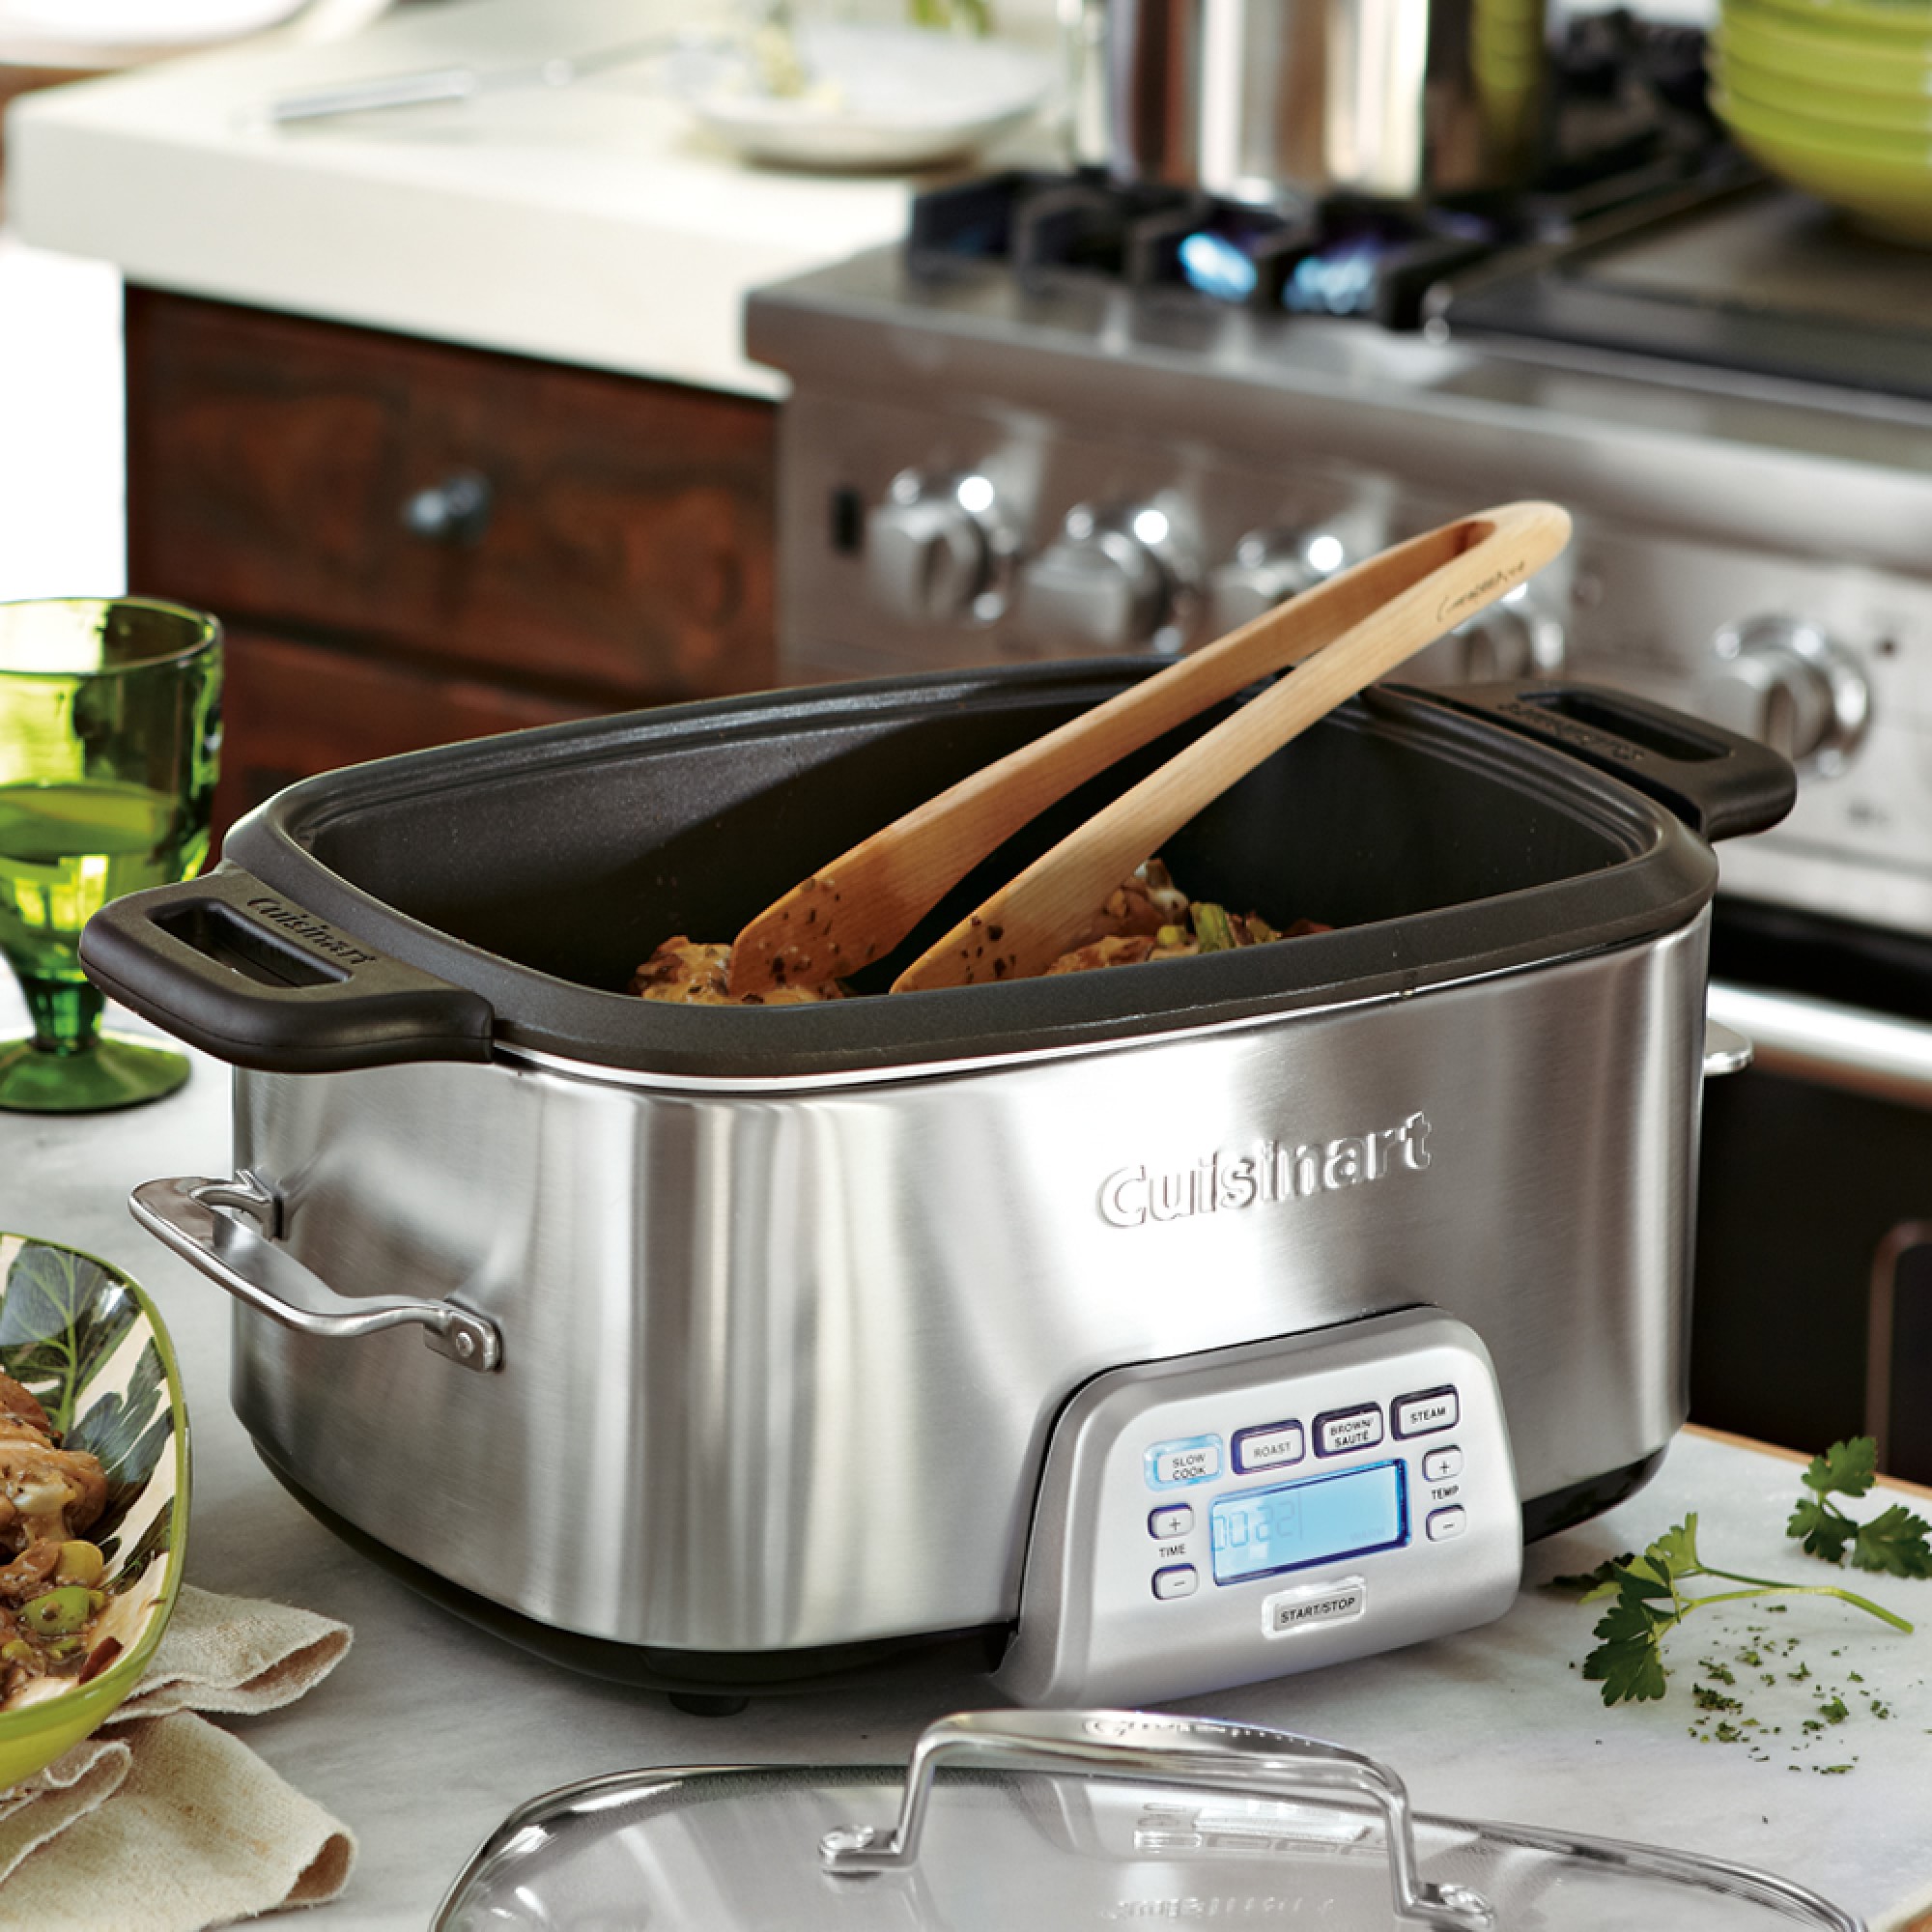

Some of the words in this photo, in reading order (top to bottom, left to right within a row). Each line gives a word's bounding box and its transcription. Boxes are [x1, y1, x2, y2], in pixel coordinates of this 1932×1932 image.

[246, 898, 377, 964] Cuisinart
[1097, 1111, 1432, 1228] Cuisinart
[1410, 1406, 1446, 1424] STEAM
[1254, 1442, 1291, 1457] ROAST
[1173, 1453, 1206, 1467] SLOW
[1173, 1466, 1206, 1480] COOK
[1432, 1485, 1459, 1499] TEMP
[1159, 1543, 1186, 1557] TIME
[1280, 1597, 1355, 1623] START/STOP
